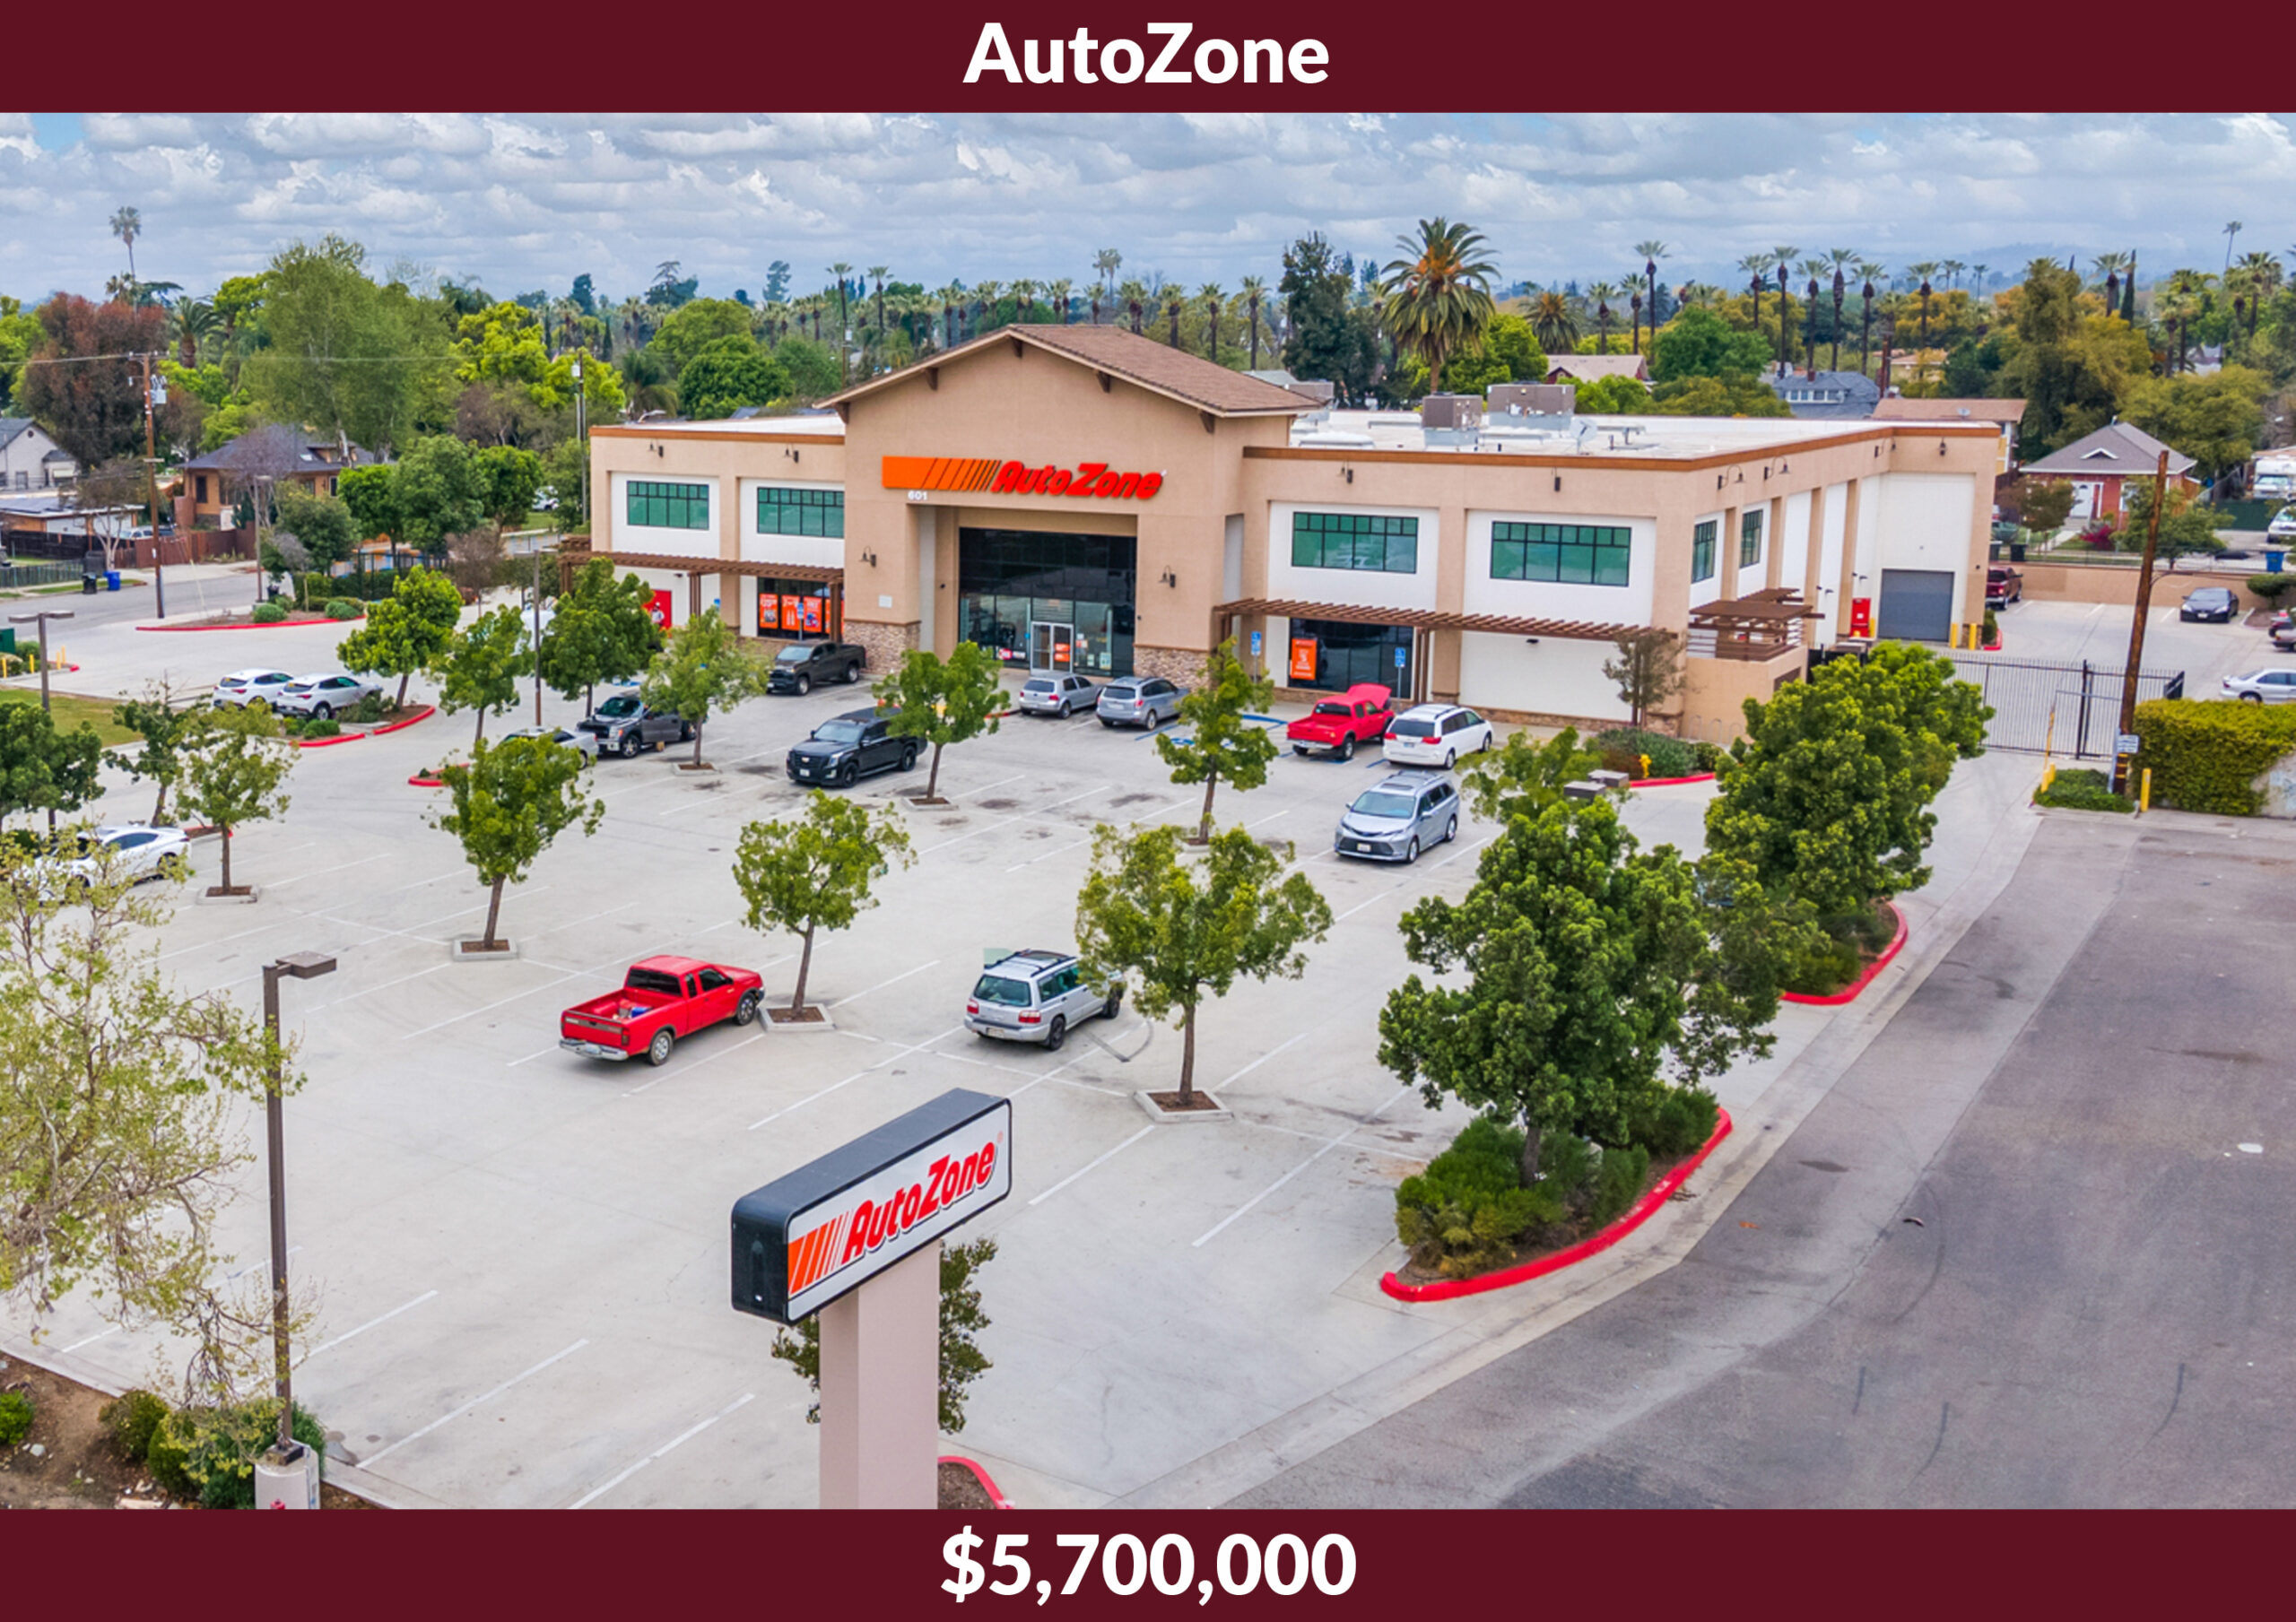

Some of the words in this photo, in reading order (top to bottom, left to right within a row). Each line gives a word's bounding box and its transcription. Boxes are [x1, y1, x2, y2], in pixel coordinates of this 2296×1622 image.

[908, 490, 928, 501] 601
[990, 460, 1163, 499] AutoZone
[840, 1141, 996, 1265] AutoZone
